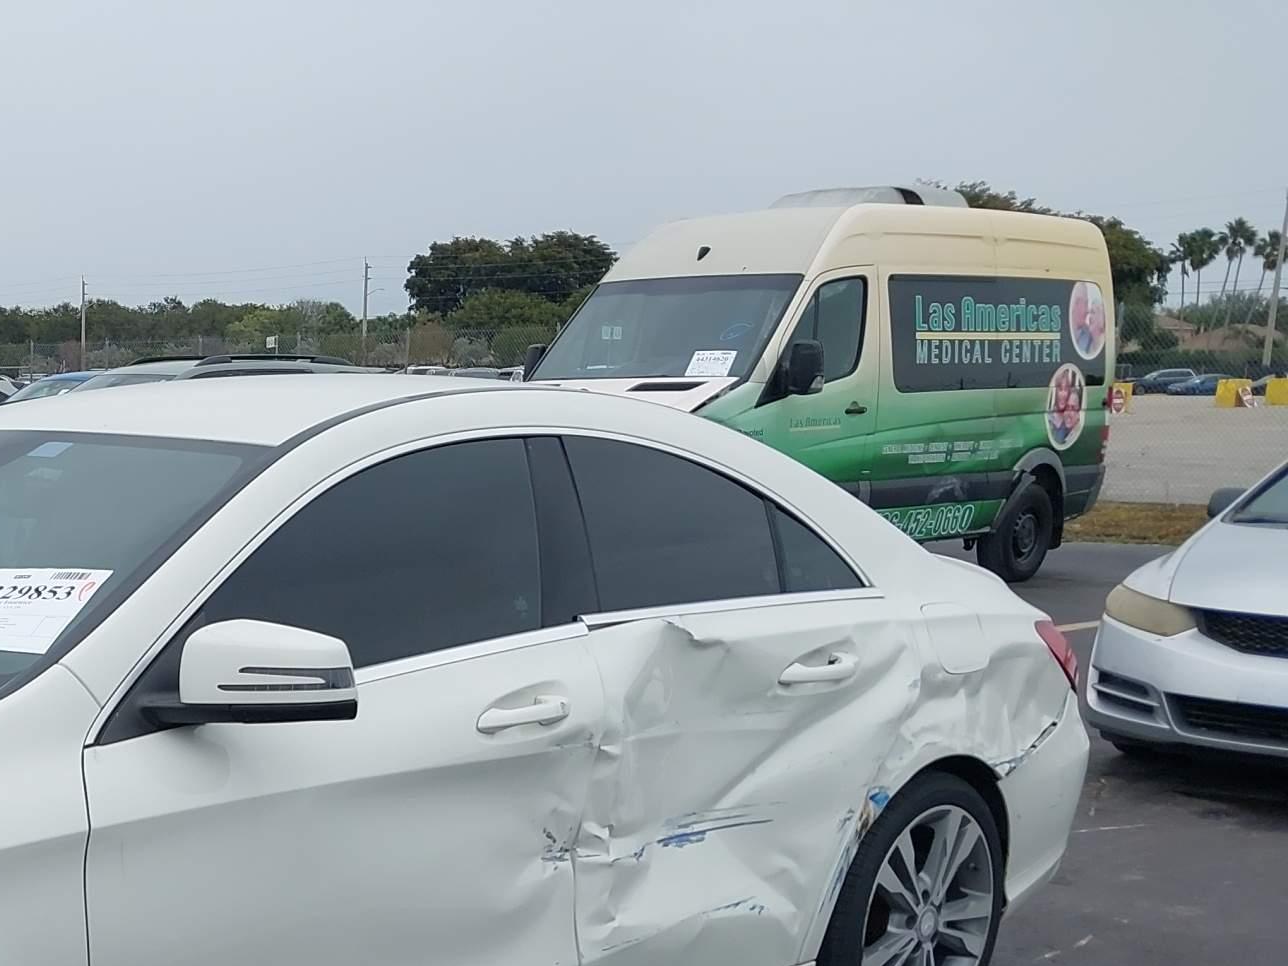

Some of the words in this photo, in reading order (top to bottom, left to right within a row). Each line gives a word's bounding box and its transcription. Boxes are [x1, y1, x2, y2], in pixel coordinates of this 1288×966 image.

[915, 295, 956, 331] Las
[961, 296, 1062, 332] Americas
[916, 339, 992, 364] MEDICAL
[1001, 339, 1061, 363] CENTER
